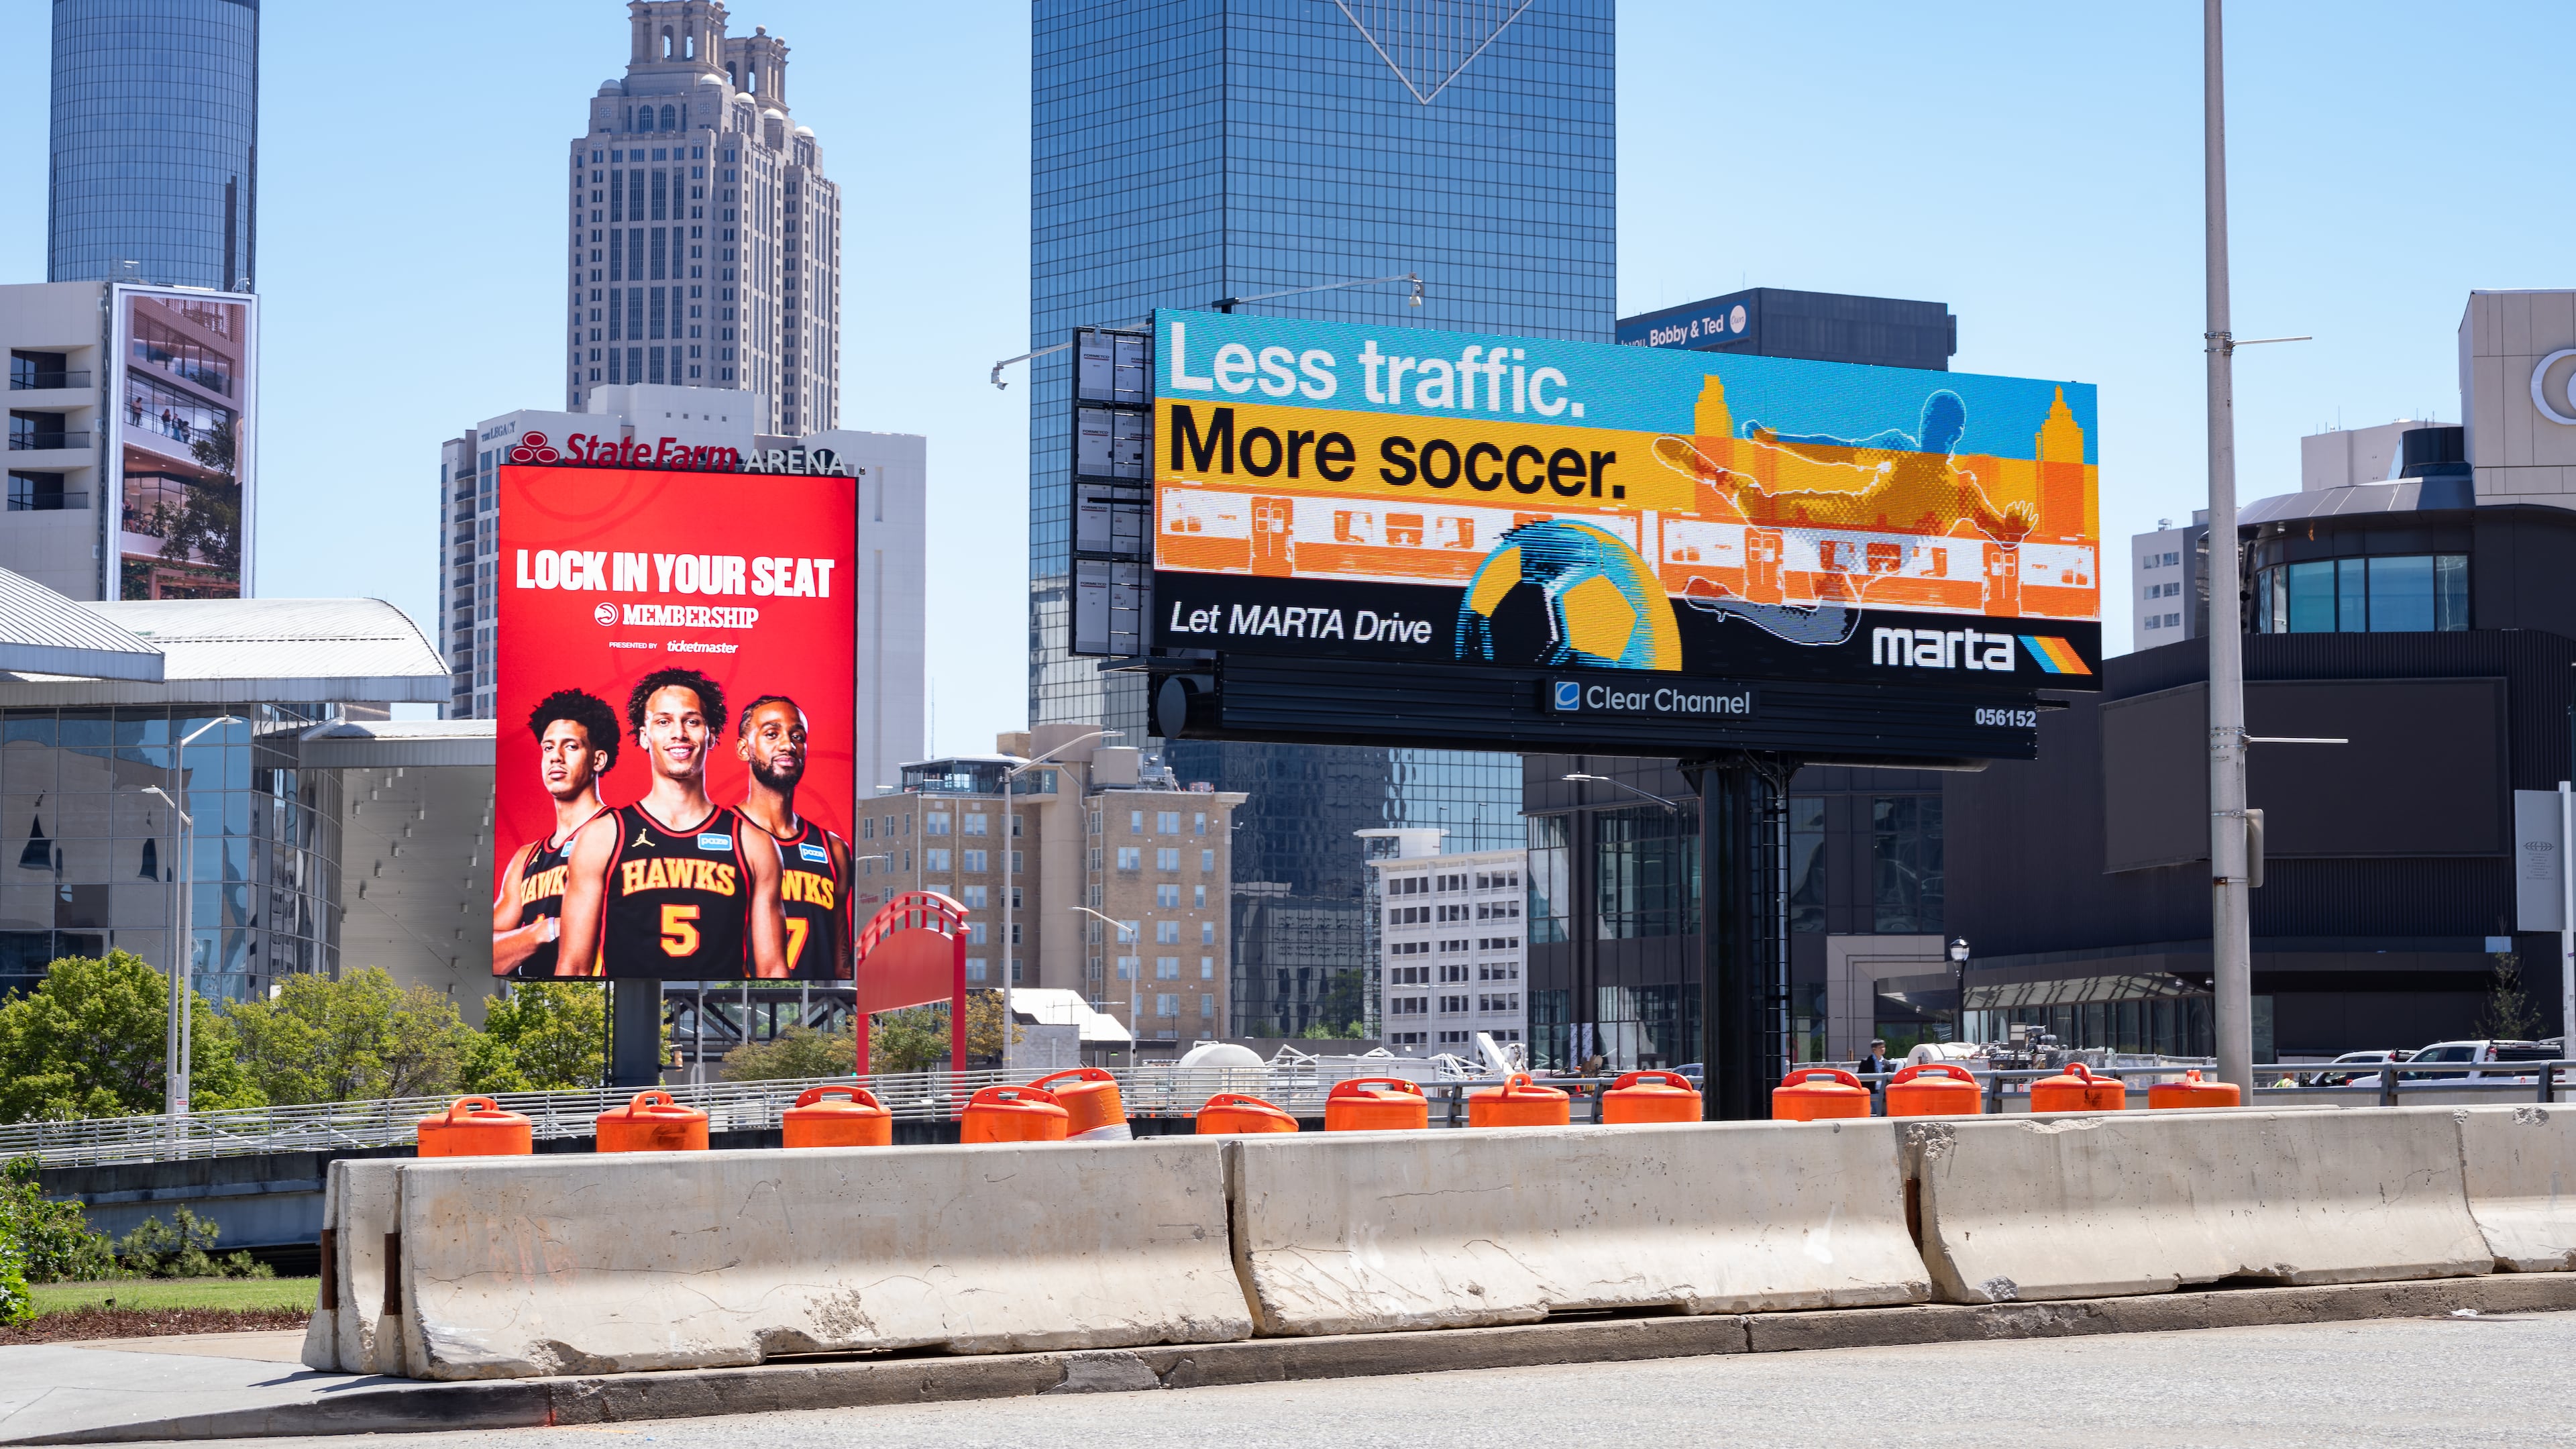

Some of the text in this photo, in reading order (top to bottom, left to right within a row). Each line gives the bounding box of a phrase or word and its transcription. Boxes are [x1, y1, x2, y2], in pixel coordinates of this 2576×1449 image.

[1650, 325, 1688, 347] Bobby
[1690, 320, 1699, 338] &
[1702, 314, 1724, 335] Ted
[1171, 322, 1584, 418] Less traffic.
[490, 421, 516, 439] LEGACY
[564, 433, 849, 476] State Farm ARENA
[1171, 404, 1625, 498] More soccer.
[517, 549, 835, 598] LOCK IN YOUR SEAT
[623, 604, 759, 629] MEMBERSHIP
[1171, 601, 1432, 643] Let MARTA Drive
[609, 641, 647, 649] PRESENTED
[667, 640, 739, 654] ticketmaster
[1872, 627, 2015, 671] marta
[1586, 685, 1750, 714] Clear Channel
[1976, 708, 2037, 728] 056152
[701, 837, 729, 846] paze
[803, 847, 824, 858] paze
[521, 865, 570, 906] HAWK
[621, 857, 735, 897] HAWKS
[781, 869, 835, 910] WKS
[660, 904, 700, 957] 5
[785, 918, 809, 970] 7
